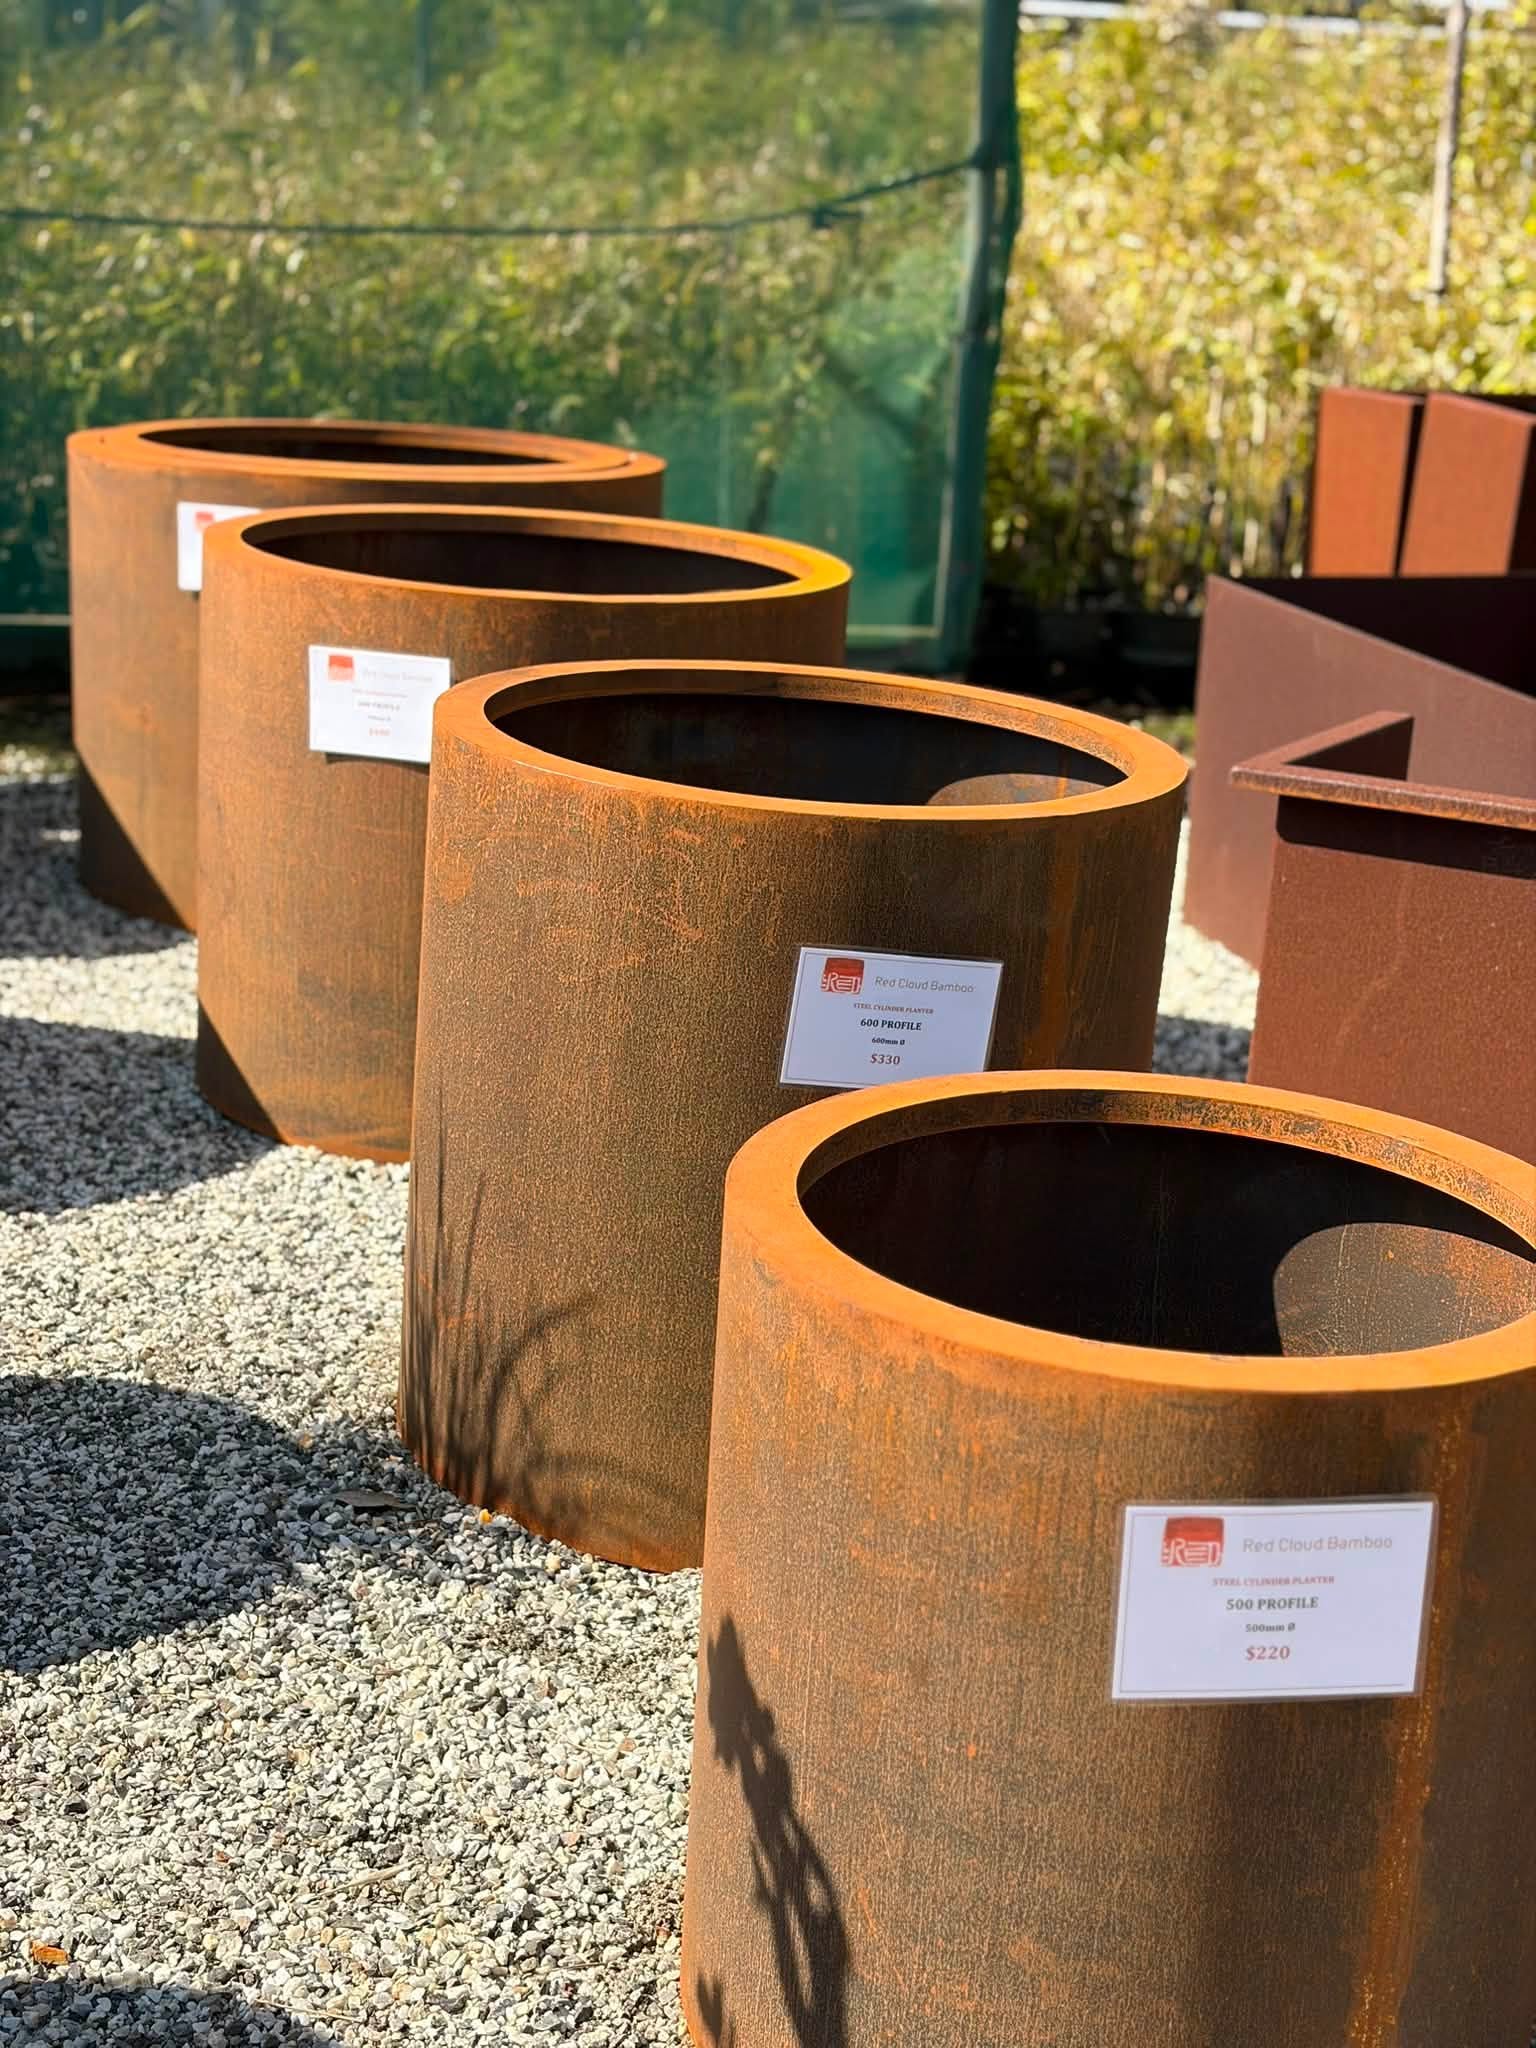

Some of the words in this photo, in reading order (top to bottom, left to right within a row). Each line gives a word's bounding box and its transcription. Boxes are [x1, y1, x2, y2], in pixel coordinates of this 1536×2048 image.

[874, 976, 896, 988] Red
[898, 978, 929, 991] Cloud
[931, 981, 975, 993] Bamboo
[873, 1004, 904, 1012] CYLINDER
[905, 1006, 934, 1014] PLANTER
[860, 1018, 879, 1028] 600
[881, 1019, 922, 1031] PROFILE
[871, 1037, 899, 1045] 600mm
[870, 1053, 901, 1065] $330
[1243, 1537, 1274, 1552] Red
[1278, 1536, 1324, 1552] Cloud
[1328, 1536, 1393, 1550] Bamboo
[1213, 1577, 1241, 1586] STEEL
[1244, 1577, 1290, 1586] CYLINDER
[1292, 1576, 1335, 1585] PLANTER
[1226, 1598, 1253, 1610] 500
[1258, 1596, 1319, 1610] PROFILE
[1245, 1623, 1285, 1632] 500mm
[1246, 1646, 1290, 1661] $220
